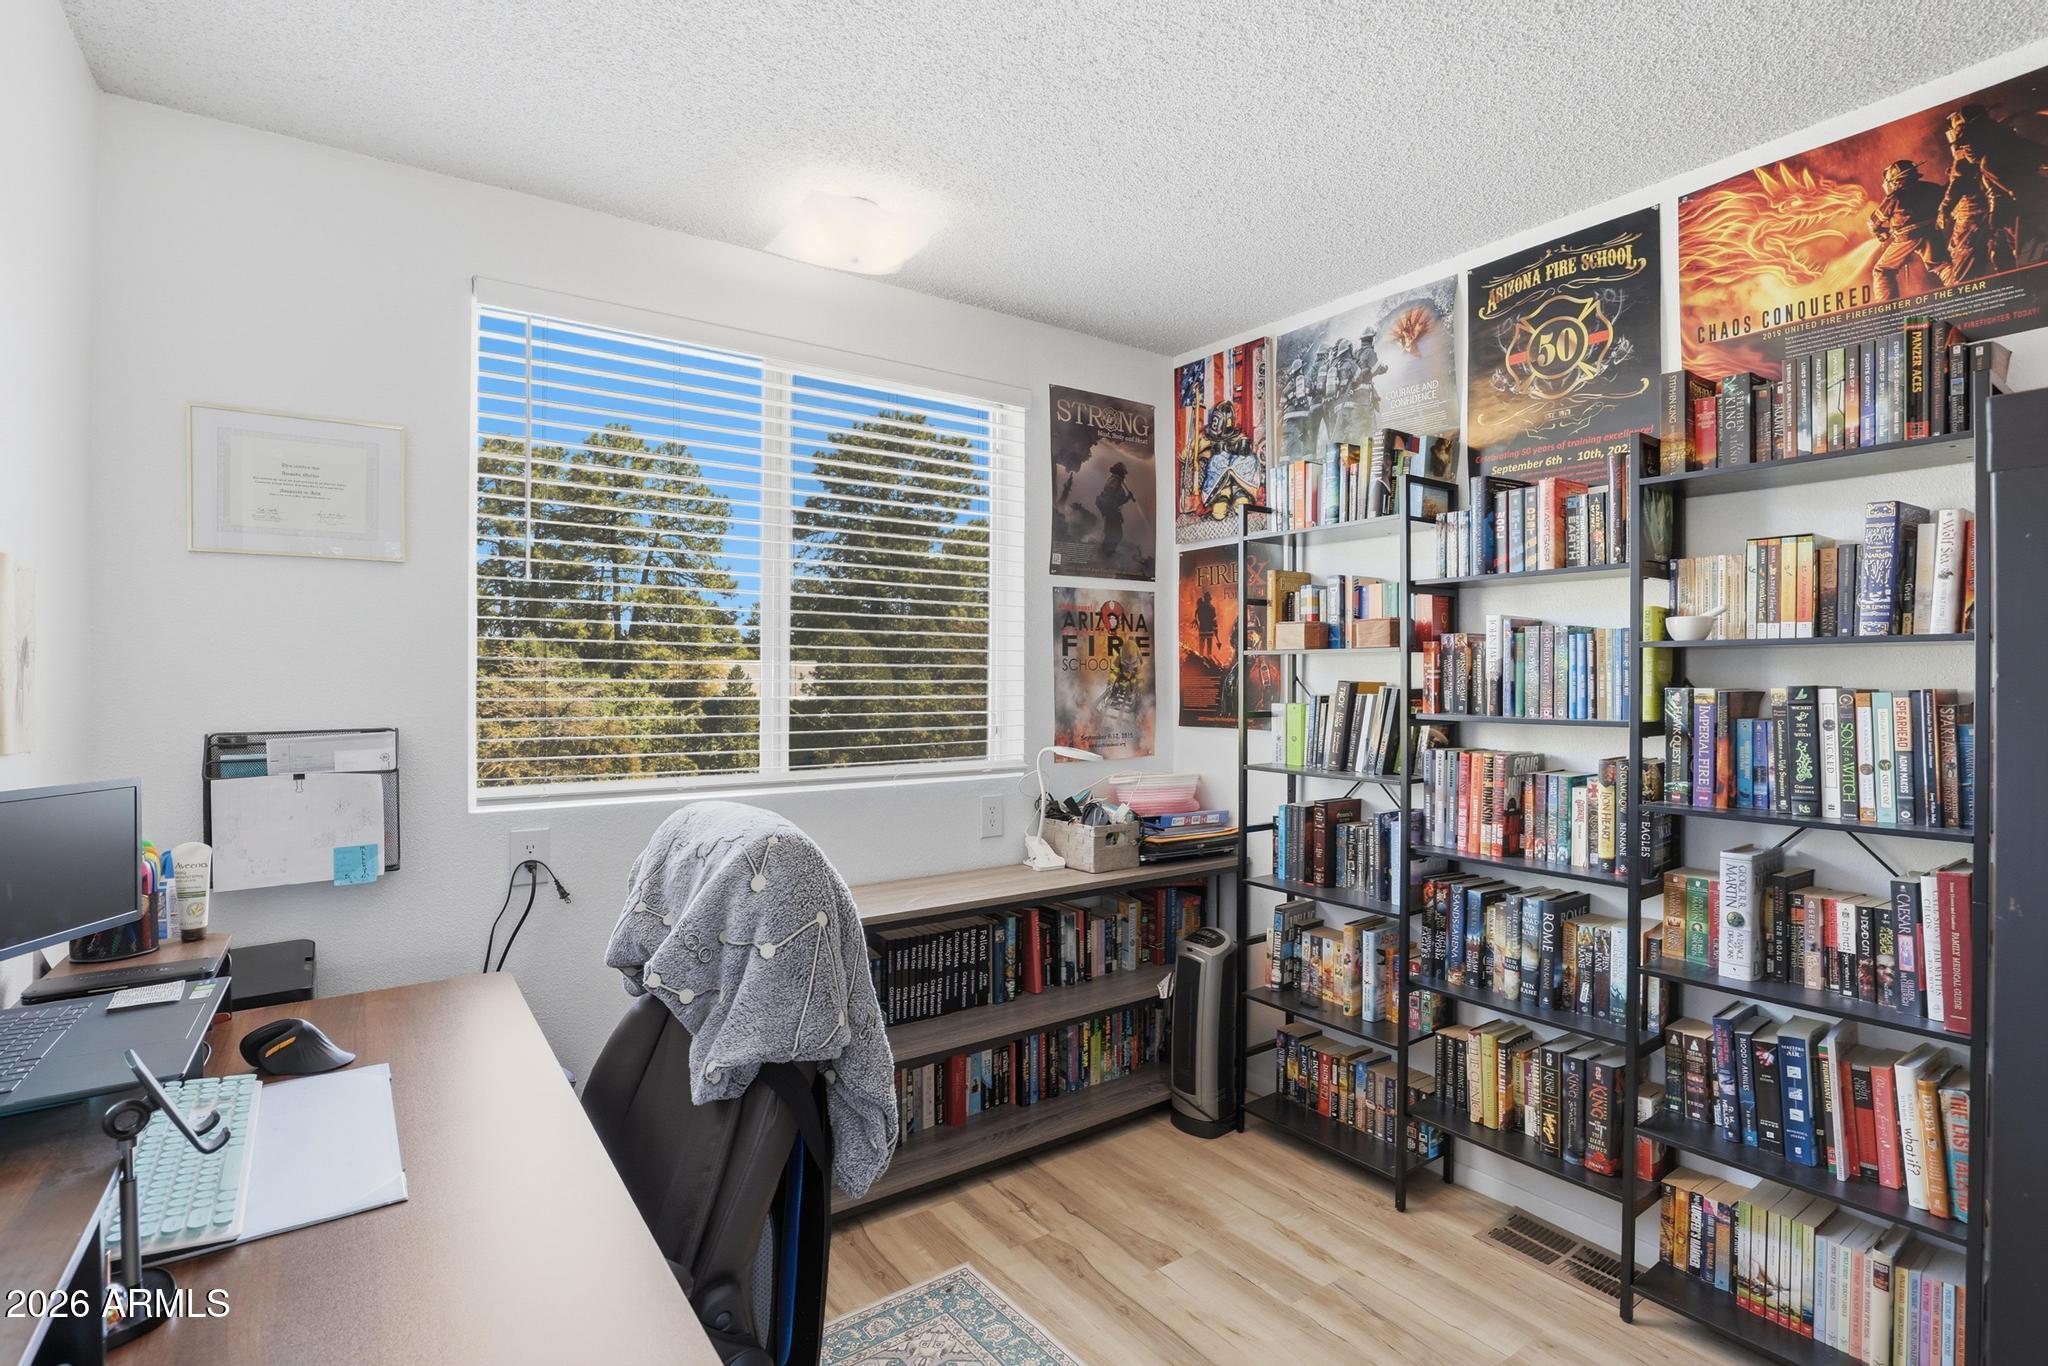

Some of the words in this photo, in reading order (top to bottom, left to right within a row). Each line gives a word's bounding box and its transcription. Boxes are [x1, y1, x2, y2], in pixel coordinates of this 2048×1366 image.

[1486, 268, 1541, 315] ARIZONA
[1545, 256, 1577, 281] FIRE
[1581, 244, 1639, 270] SCHOOL
[1697, 315, 1751, 344] CHAOS
[1762, 284, 1871, 328] CONQUERED
[1762, 330, 1781, 341] 2019
[1785, 321, 1817, 335] UNITED
[1820, 315, 1841, 326] FIRE
[1845, 299, 1911, 320] FIREFIGHTER
[1915, 294, 1928, 305] OF
[1933, 289, 1953, 300] THE
[1958, 281, 1986, 294] YEAR
[1537, 327, 1578, 367] 50
[1912, 331, 1922, 366] PANZER
[1386, 383, 1421, 400] COURAGE
[1422, 379, 1439, 391] AND
[1668, 374, 1677, 404] STEPHEN
[1912, 370, 1922, 393] ACES
[1390, 390, 1437, 408] CONFIDENCE
[1725, 397, 1736, 430] KING
[1735, 390, 1745, 432] STEPHEN
[1668, 404, 1677, 424] KING
[1532, 445, 1554, 458] years
[1556, 440, 1566, 450] of
[1567, 436, 1601, 450] training
[1491, 460, 1544, 475] September
[1545, 455, 1562, 466] 6th
[1577, 449, 1604, 462] 10th,
[1568, 516, 1576, 560] EARTH
[1063, 610, 1148, 633] ARIZONA
[1061, 634, 1150, 657] FIRE
[1338, 686, 1346, 708] TROY
[1673, 705, 1683, 734] HAWK
[1698, 705, 1711, 756] IMPERIAL
[1896, 701, 1908, 748] SPEARHEAD
[1670, 735, 1681, 765] QUEST
[1841, 723, 1854, 749] SON
[1826, 734, 1835, 774] WICKED
[1900, 755, 1908, 772] ADAM
[1482, 757, 1494, 783] CRAIG
[1698, 758, 1711, 785] FIRE
[1842, 762, 1855, 802] WITCH
[1482, 786, 1494, 825] JOHNSON
[1601, 792, 1612, 811] LION
[1601, 813, 1612, 841] HEART
[1641, 821, 1651, 858] EAGLES
[175, 862, 208, 870] Aveeno
[1725, 863, 1738, 908] MARTIN
[1451, 894, 1460, 924] SANDS
[1896, 893, 1911, 933] CAESAR
[979, 930, 987, 961] Fallout
[1451, 928, 1460, 958] ARENA
[1542, 913, 1554, 953] ROME
[1951, 932, 1960, 956] FAMILY
[1595, 952, 1603, 972] KANE
[1861, 940, 1870, 957] CITY
[1952, 957, 1961, 987] MEDICAL
[1954, 988, 1962, 1010] GUIDE
[1739, 1037, 1747, 1058] BLOOD
[1543, 1071, 1554, 1094] KING
[1588, 1083, 1604, 1121] KING
[1922, 1094, 1935, 1134] DEWEY
[1950, 1095, 1968, 1117] THE
[1904, 1127, 1919, 1156] what
[1951, 1123, 1969, 1154] LAST
[1907, 1159, 1921, 1176] if?
